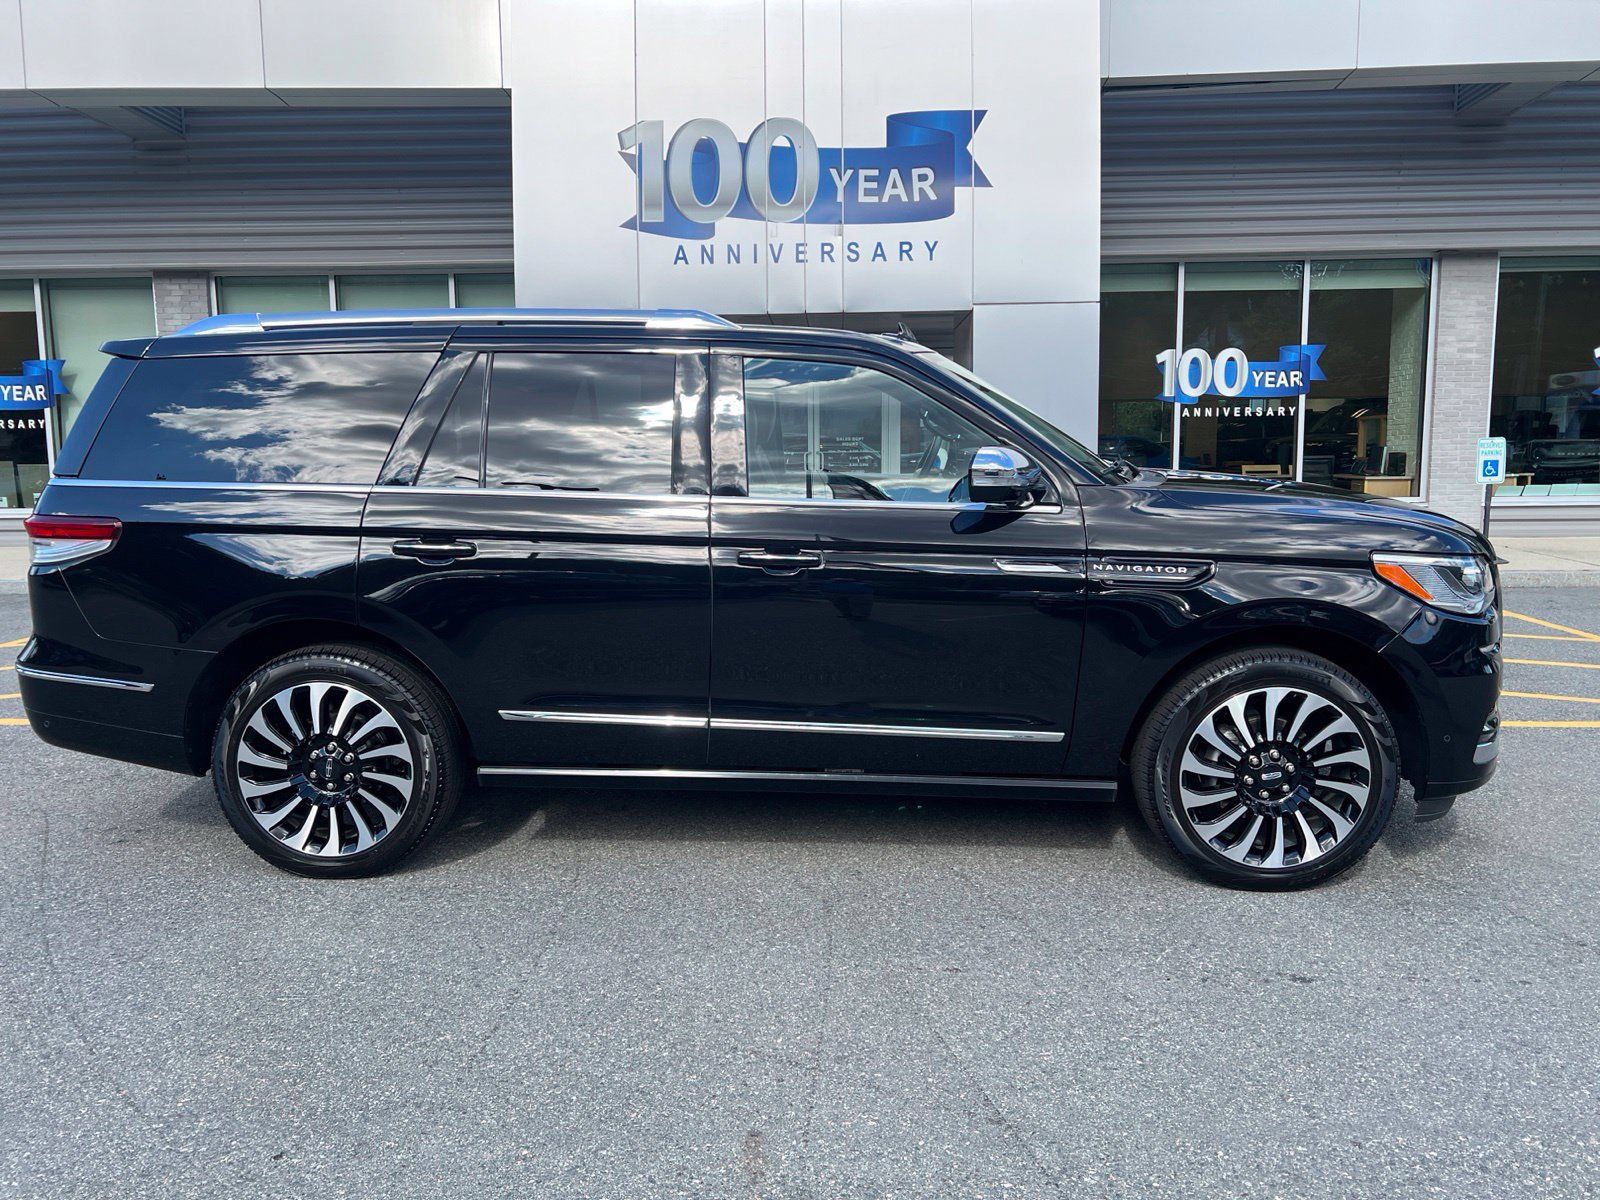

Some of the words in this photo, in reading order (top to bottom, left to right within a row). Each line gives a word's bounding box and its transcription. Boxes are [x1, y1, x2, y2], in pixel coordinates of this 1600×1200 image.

[617, 117, 820, 223] 100
[829, 166, 937, 203] YEAR
[673, 240, 939, 266] ANNIVERSARY
[1155, 347, 1249, 397] 100
[1252, 370, 1303, 388] YEAR
[0, 384, 47, 401] YEAR
[1182, 406, 1296, 418] ANNIVERSARY
[1093, 563, 1188, 574] NAVIGATOR
